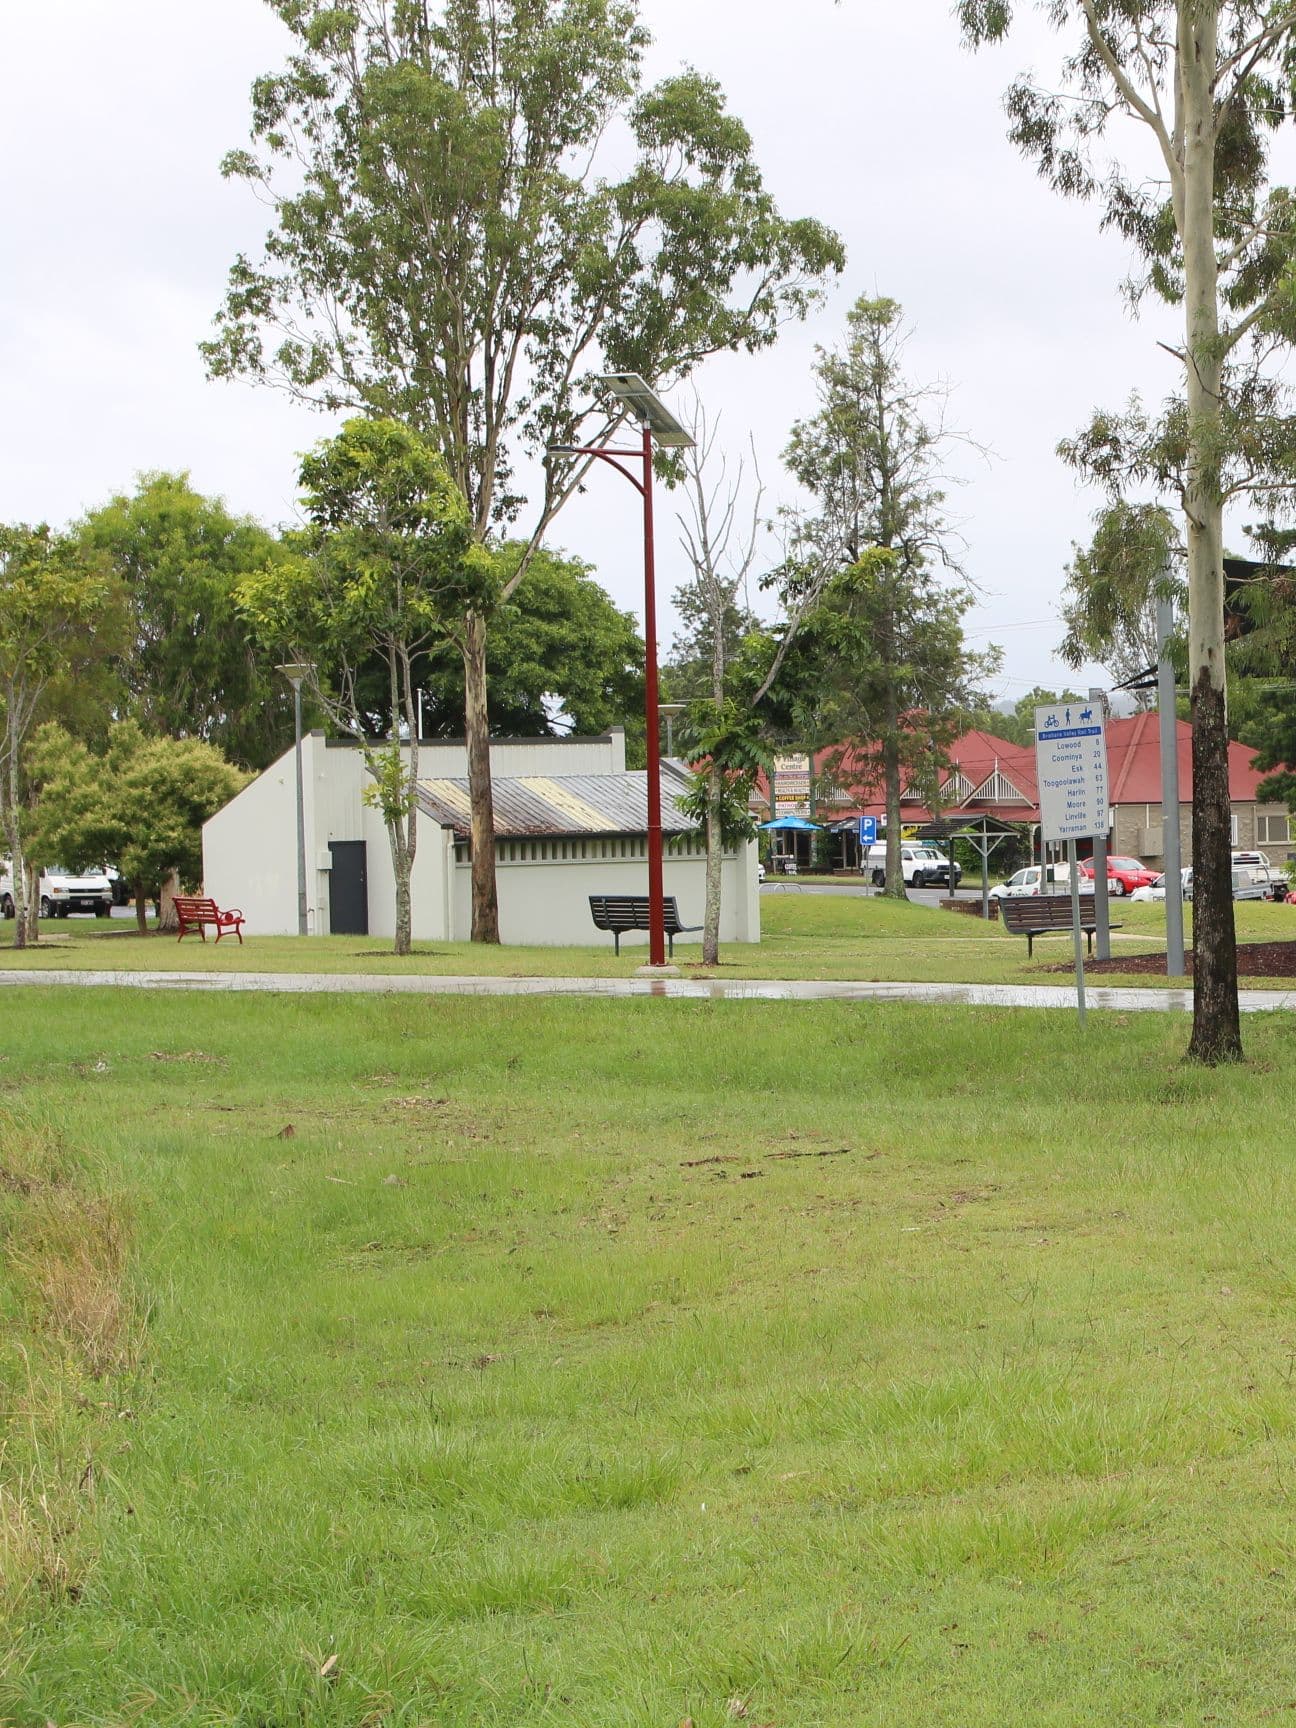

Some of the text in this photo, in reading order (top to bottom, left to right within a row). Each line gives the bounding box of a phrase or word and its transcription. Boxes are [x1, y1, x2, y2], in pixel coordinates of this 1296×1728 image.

[1057, 741, 1082, 749] Lowood
[1052, 753, 1082, 762] Coominya
[1071, 765, 1083, 773] Esk
[1043, 776, 1085, 788] Toogoolawah
[1067, 786, 1103, 797] Harlin 77
[1065, 811, 1087, 820] Linville
[864, 819, 873, 830] P
[1059, 824, 1087, 833] Yarraman
